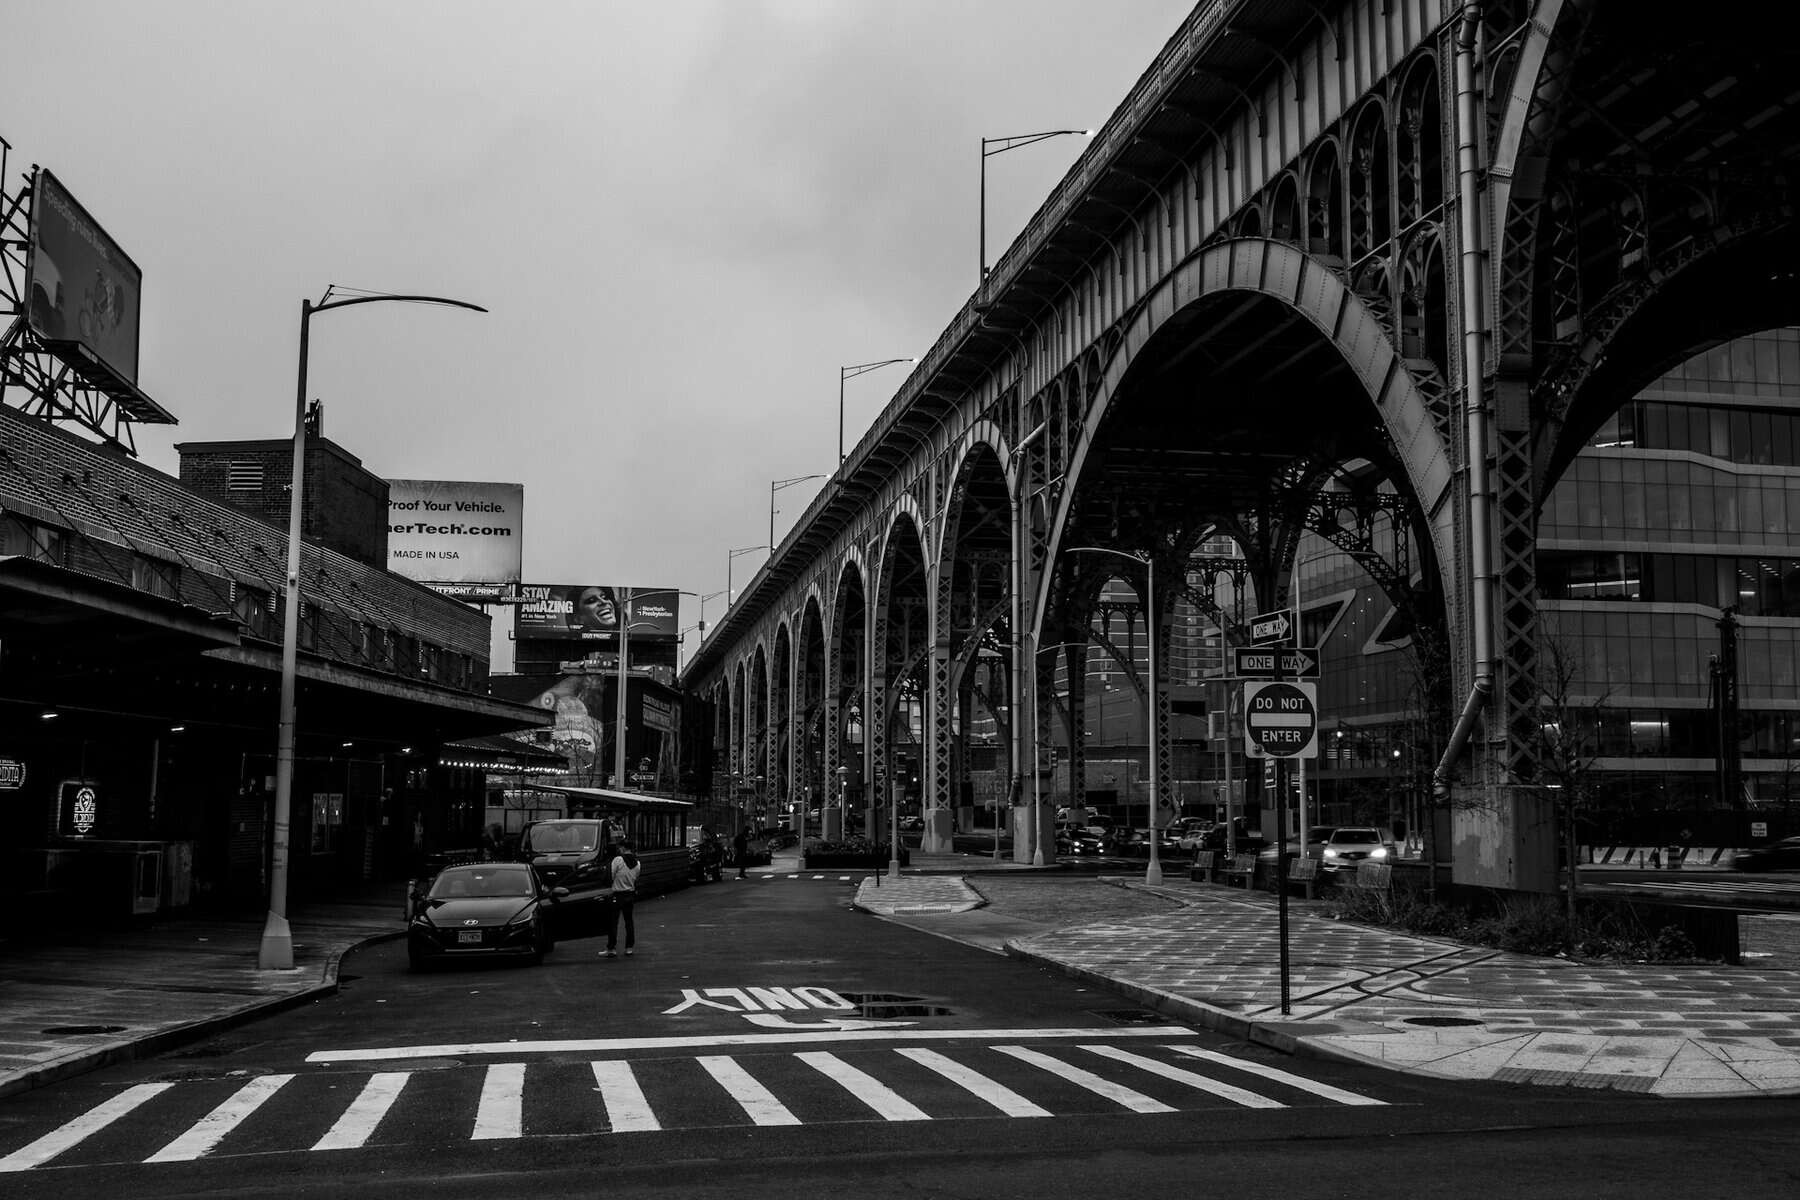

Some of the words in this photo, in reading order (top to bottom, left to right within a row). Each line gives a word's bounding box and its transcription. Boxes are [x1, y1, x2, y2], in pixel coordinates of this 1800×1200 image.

[422, 500, 452, 512] Your
[455, 500, 506, 513] Vehicle.
[393, 550, 423, 559] MADE
[425, 551, 436, 559] IN
[438, 551, 460, 560] USA
[521, 586, 551, 600] STAY
[521, 600, 574, 614] AMAZING
[1255, 623, 1268, 637] ONE
[1272, 620, 1285, 633] WAY
[1247, 655, 1272, 669] ONE
[1281, 656, 1308, 669] WAY
[1256, 697, 1273, 710] DO
[1280, 697, 1305, 710] NOT
[1261, 730, 1302, 743] ENTER
[660, 986, 858, 1014] ONLY
